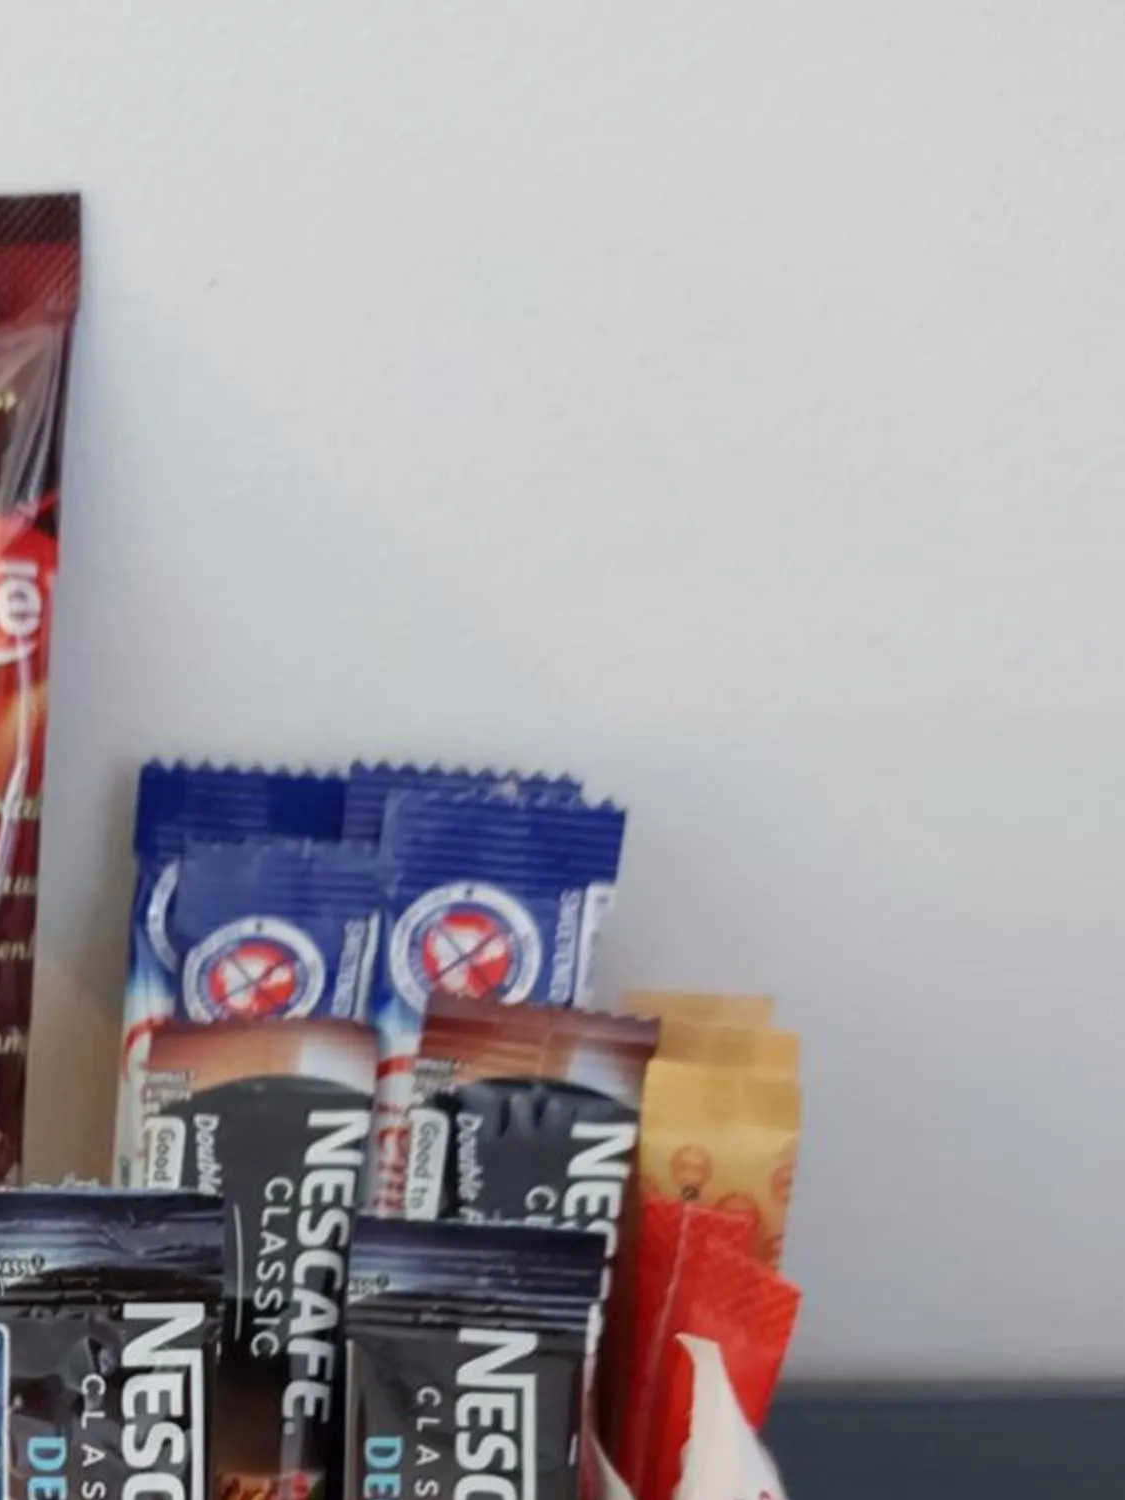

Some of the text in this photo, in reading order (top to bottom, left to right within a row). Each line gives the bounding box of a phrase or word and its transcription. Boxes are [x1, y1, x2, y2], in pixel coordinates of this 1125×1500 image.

[153, 1128, 176, 1183] Good
[411, 1121, 440, 1179] Good
[250, 1176, 294, 1358] CLASSIC
